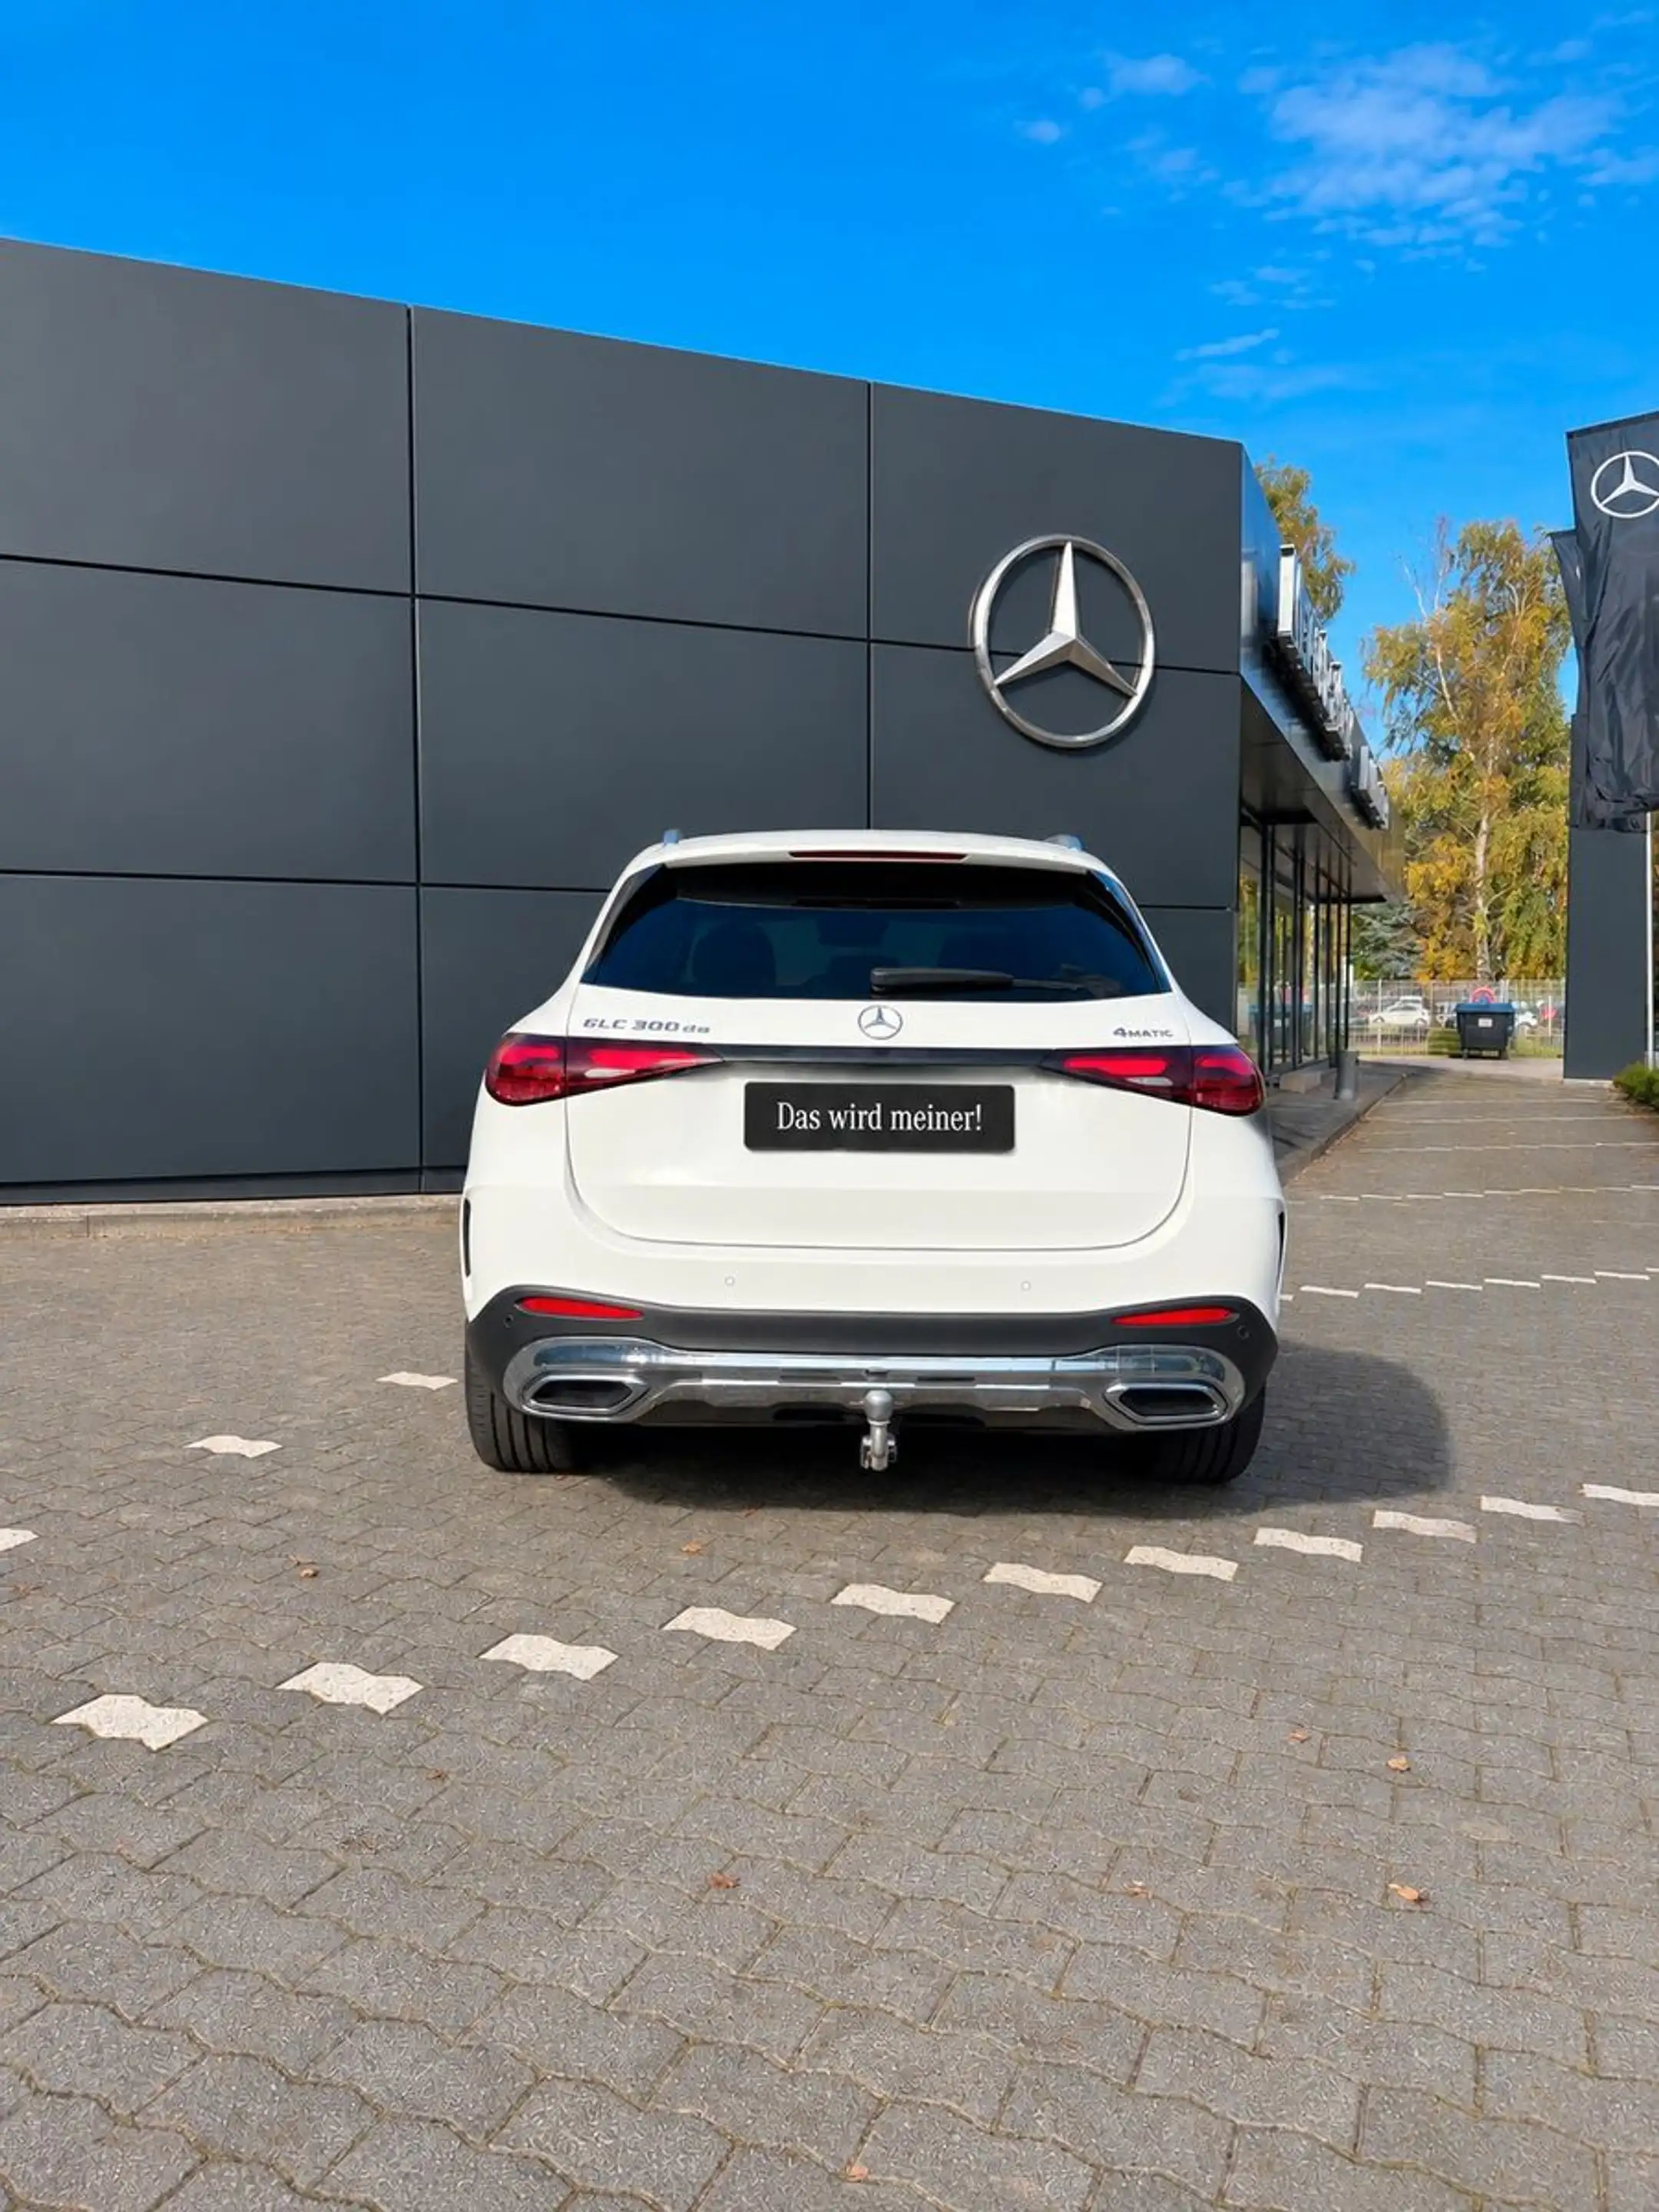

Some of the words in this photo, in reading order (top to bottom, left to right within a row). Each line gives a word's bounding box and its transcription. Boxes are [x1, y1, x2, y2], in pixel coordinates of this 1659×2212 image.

[583, 1018, 627, 1030] GLC
[631, 1019, 680, 1031] 300
[1113, 1027, 1174, 1038] 4MATIC
[777, 1101, 822, 1130] Das
[828, 1102, 882, 1131] wird
[889, 1103, 983, 1131] meiner!
